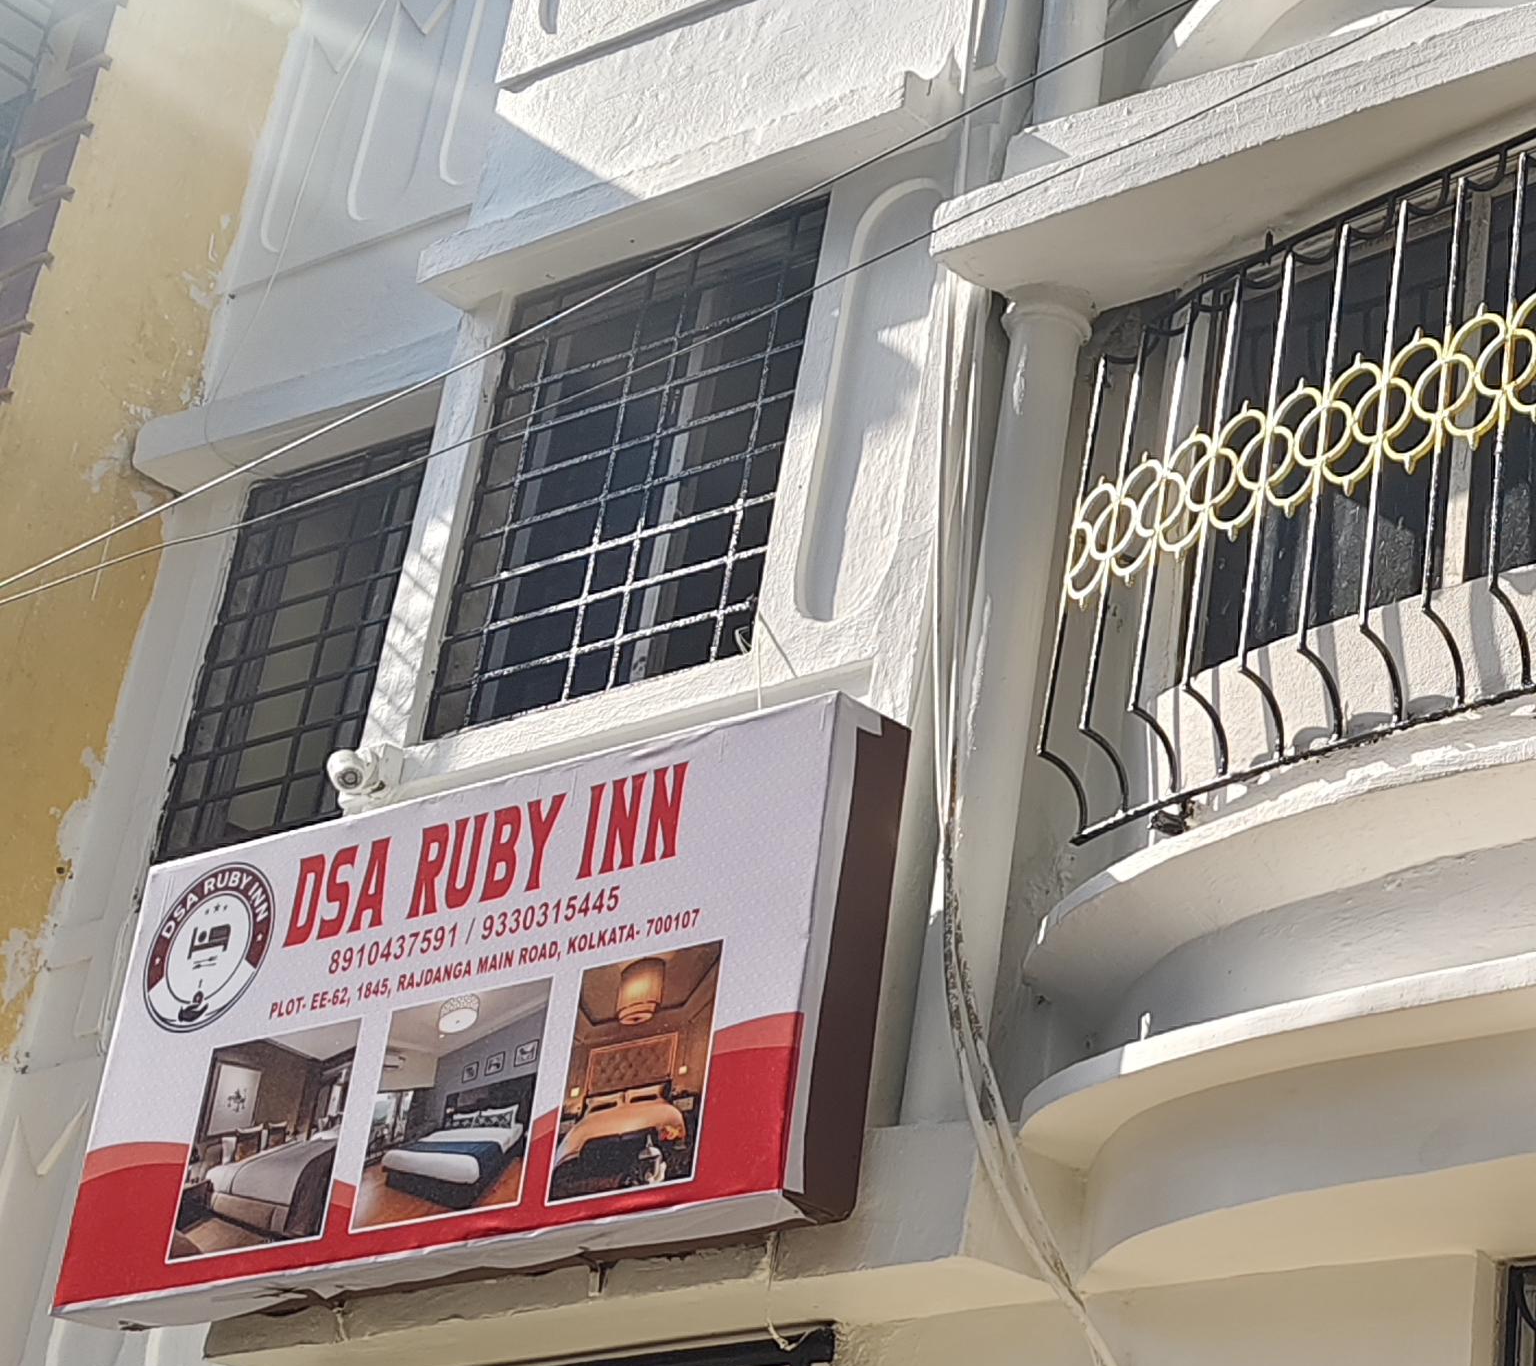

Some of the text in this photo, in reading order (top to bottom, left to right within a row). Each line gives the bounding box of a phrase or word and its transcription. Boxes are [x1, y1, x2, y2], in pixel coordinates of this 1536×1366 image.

[282, 761, 689, 948] DSA RUBY INN
[161, 871, 269, 939] DSA RUBY INN
[328, 886, 620, 975] 8910437591 / 9330315445
[269, 908, 700, 1019] PLOT- EE-62, 1845, RAJDANGA MAIN ROAD, KOLKATA- 700107
